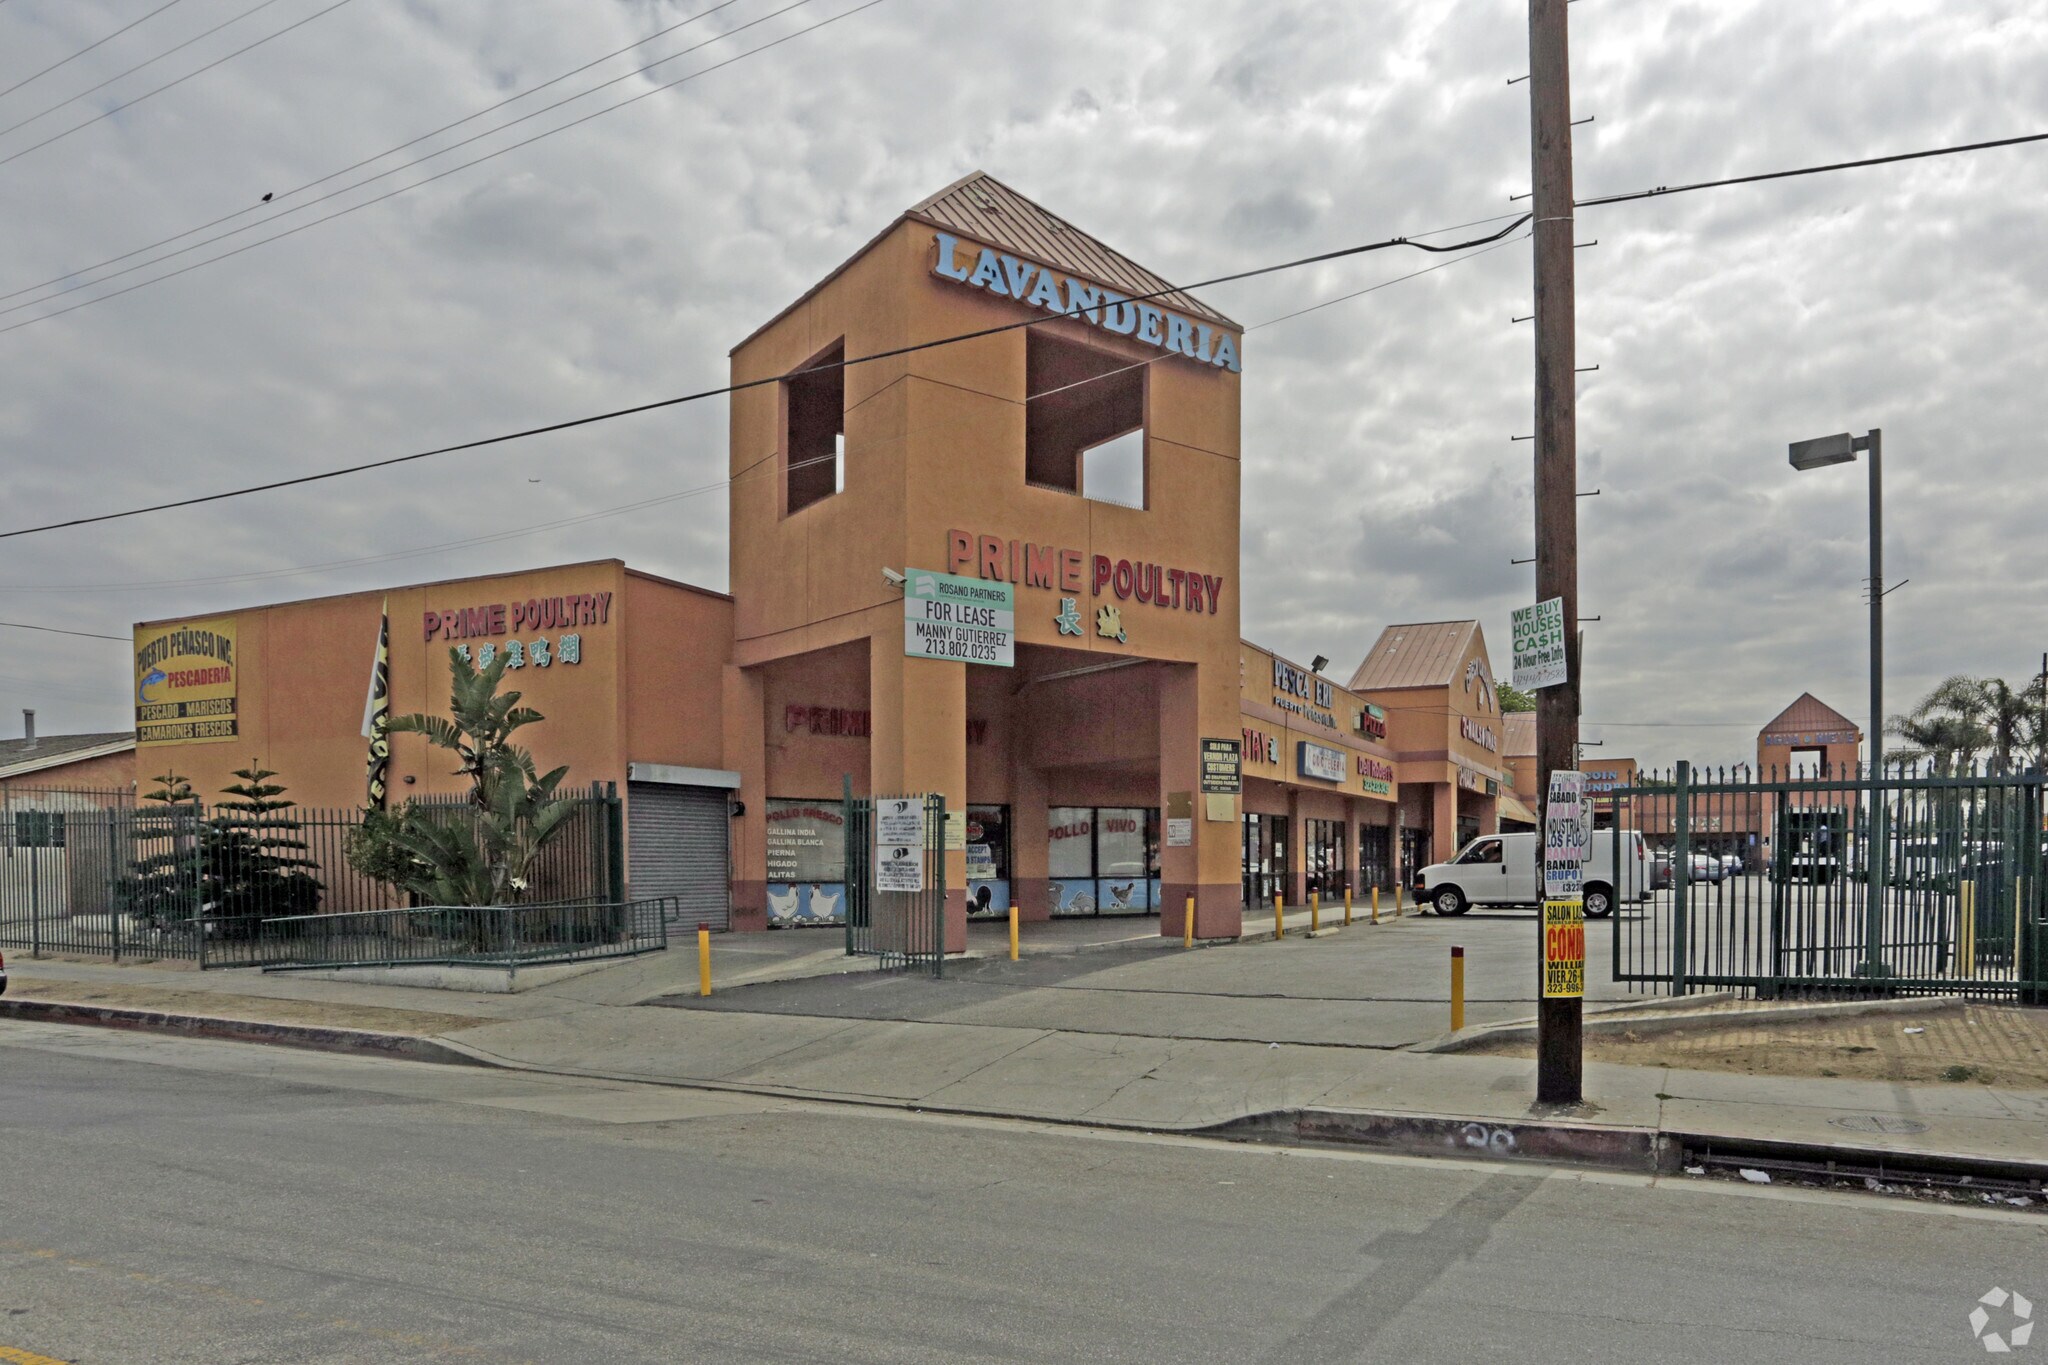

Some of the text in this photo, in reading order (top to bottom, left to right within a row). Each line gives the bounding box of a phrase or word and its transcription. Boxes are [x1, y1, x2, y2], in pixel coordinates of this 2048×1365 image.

[934, 232, 1242, 373] LAVANDERIA
[947, 528, 1223, 614] PRIME POULTRY
[939, 582, 968, 597] ROSANO
[970, 587, 1006, 602] PARTNERS
[423, 592, 611, 642] PRIME POULTRY
[926, 601, 995, 627] FOR LEASE
[1512, 600, 1559, 622] WE BUY
[916, 622, 1007, 647] MANNY GUTIERREZ
[1513, 614, 1561, 638] HOUSES
[137, 636, 168, 677] PUERTO
[170, 626, 215, 659] PEÑASCO
[925, 638, 996, 661] 213.802.0235
[1513, 630, 1562, 652] CA$H
[1523, 654, 1536, 668] Hour
[1538, 650, 1550, 664] Free
[1551, 645, 1563, 661] Info
[168, 666, 231, 688] PESCADERIA
[1273, 659, 1309, 699] PESCA
[141, 699, 231, 720] PESCADO MARISCOS
[141, 720, 232, 741] CAMARONES FRESCOS
[1549, 792, 1577, 804] SABADO
[803, 808, 842, 825] FRESCO
[767, 828, 796, 836] GALLINA
[1048, 819, 1136, 843] POLLO VIVO
[1547, 834, 1563, 848] LOS
[767, 849, 796, 857] PIERNA
[767, 860, 798, 868] HIGADO
[1547, 848, 1582, 860] BANDA
[1546, 871, 1577, 881] GRUPO
[1547, 860, 1580, 871] BANDA
[1547, 905, 1571, 921] SALON
